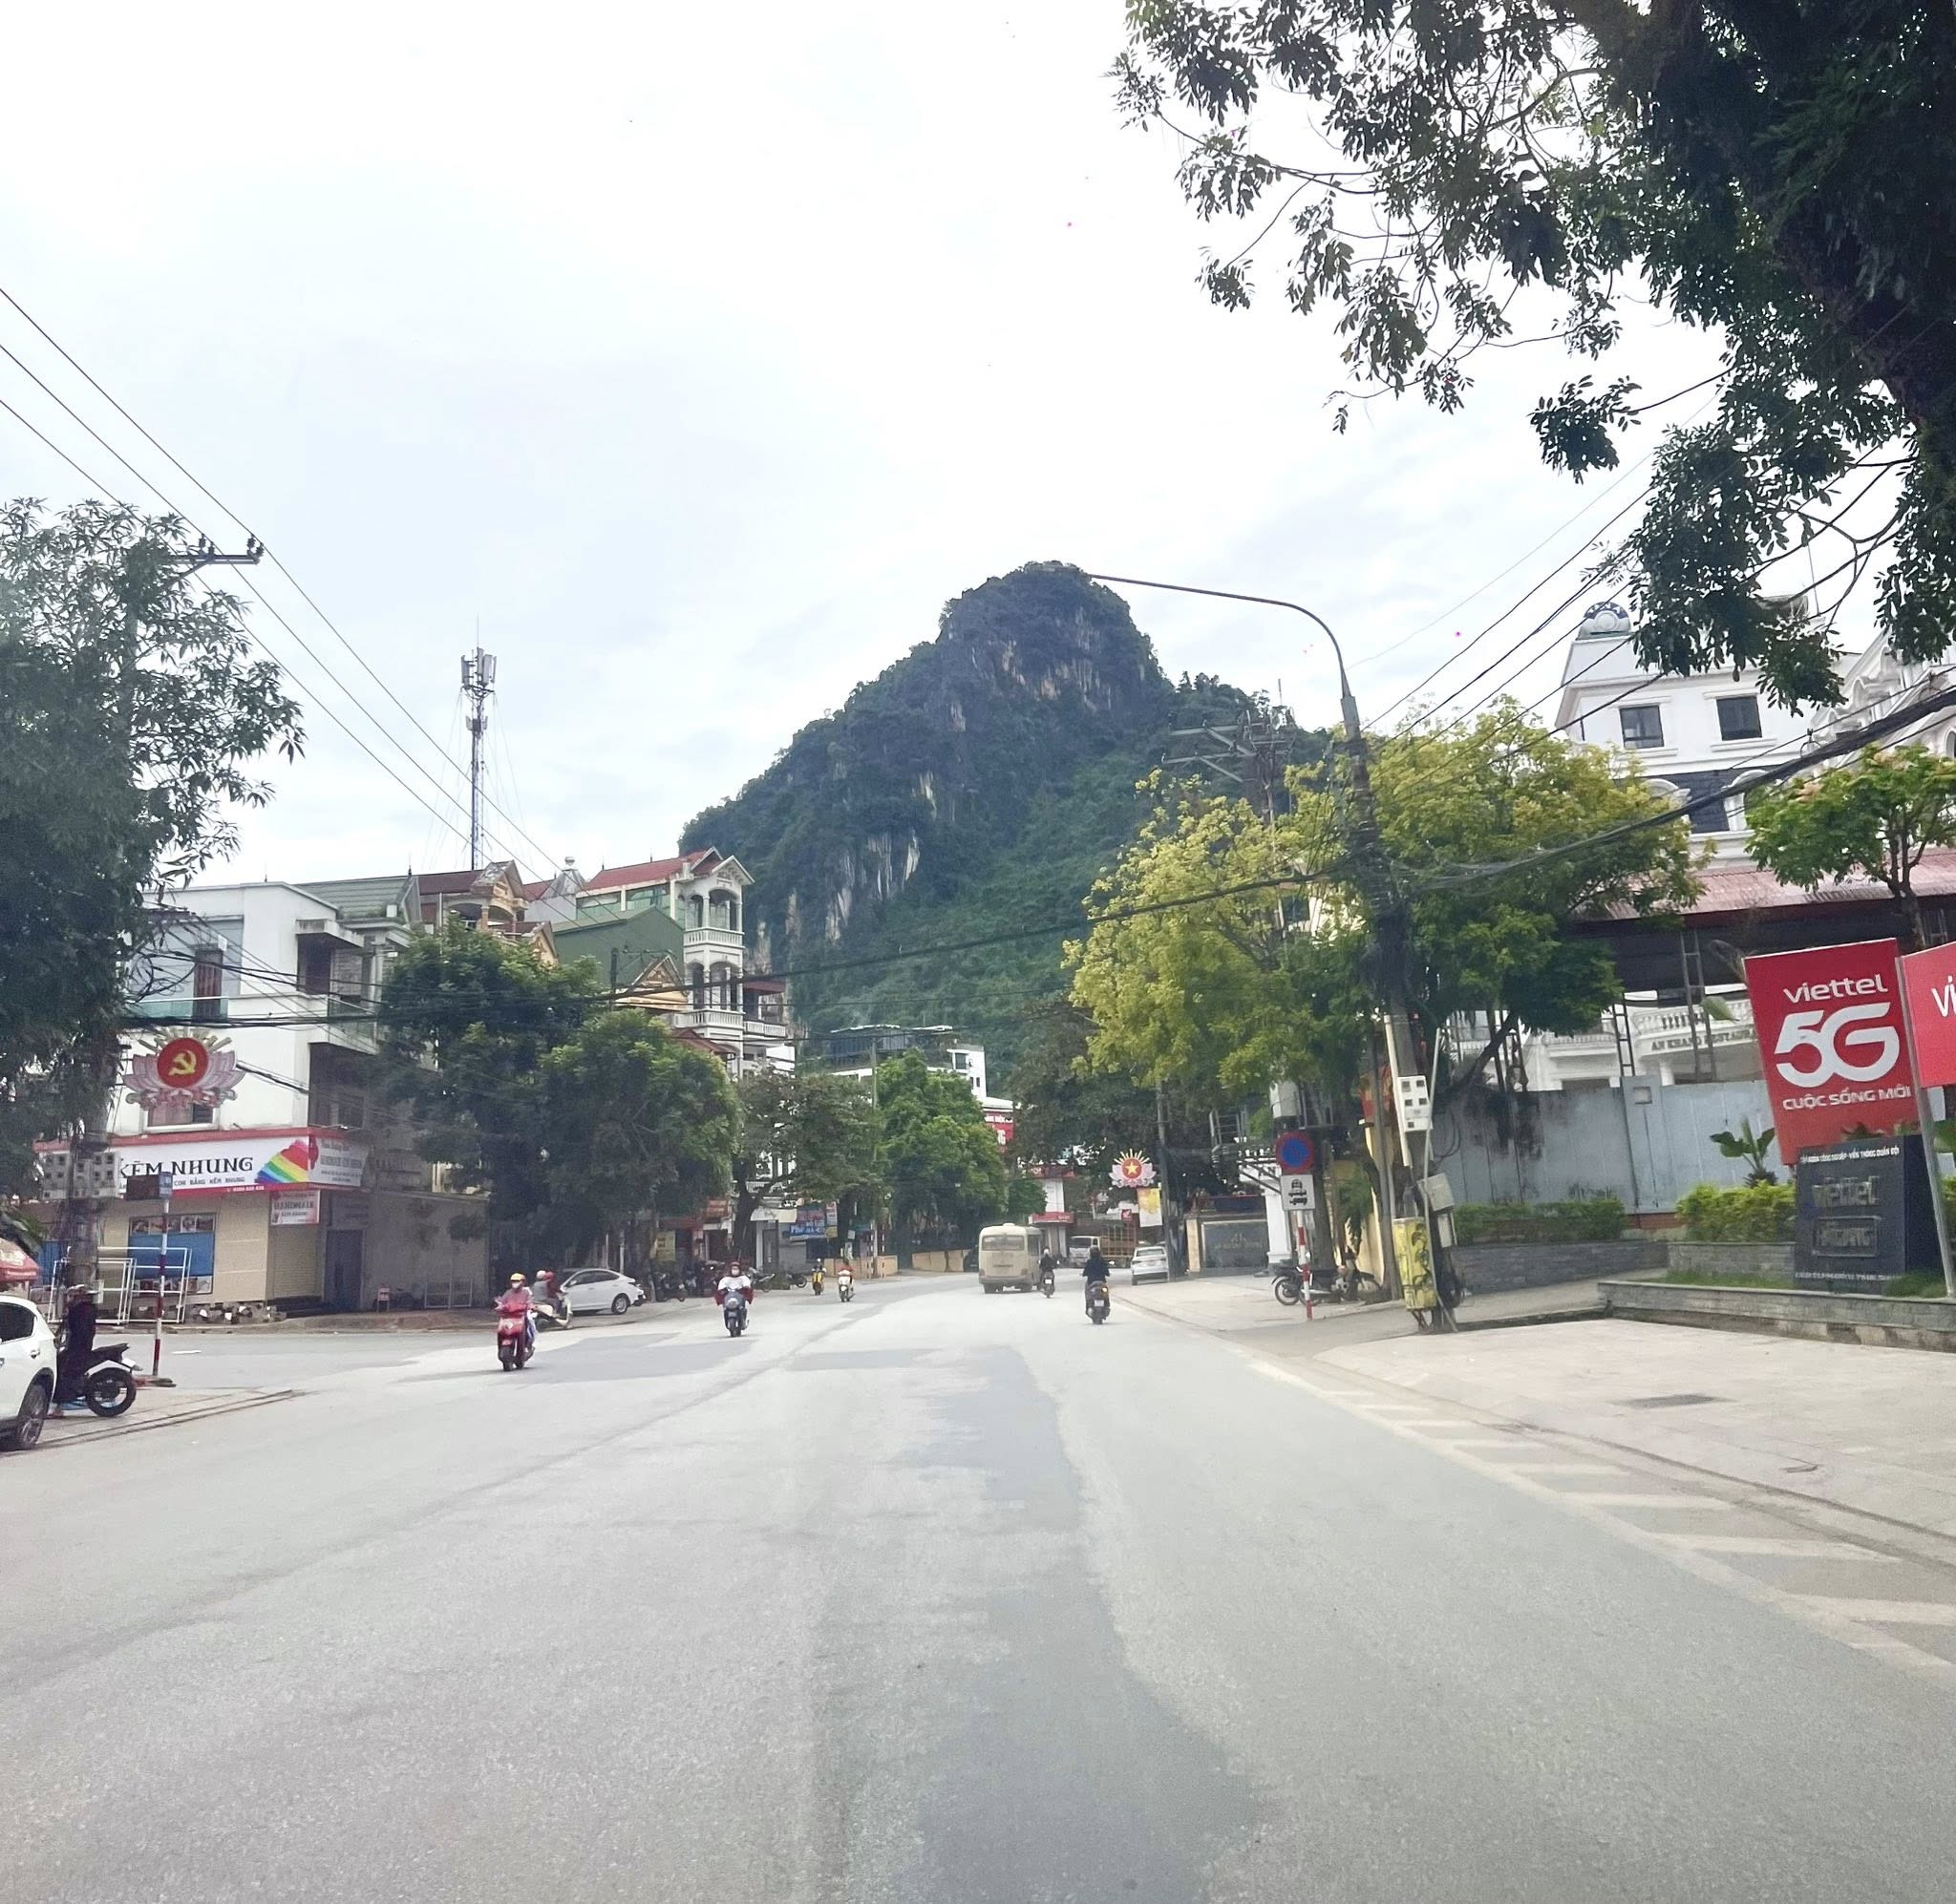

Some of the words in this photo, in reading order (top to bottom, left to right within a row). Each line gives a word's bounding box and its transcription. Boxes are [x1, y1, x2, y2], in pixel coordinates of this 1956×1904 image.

[1783, 974, 1889, 1004] viettel
[1775, 1002, 1900, 1088] 5G
[1782, 1093, 1827, 1111] CUỘC
[1828, 1087, 1877, 1105] SỐNG
[171, 1156, 254, 1176] NHUNG
